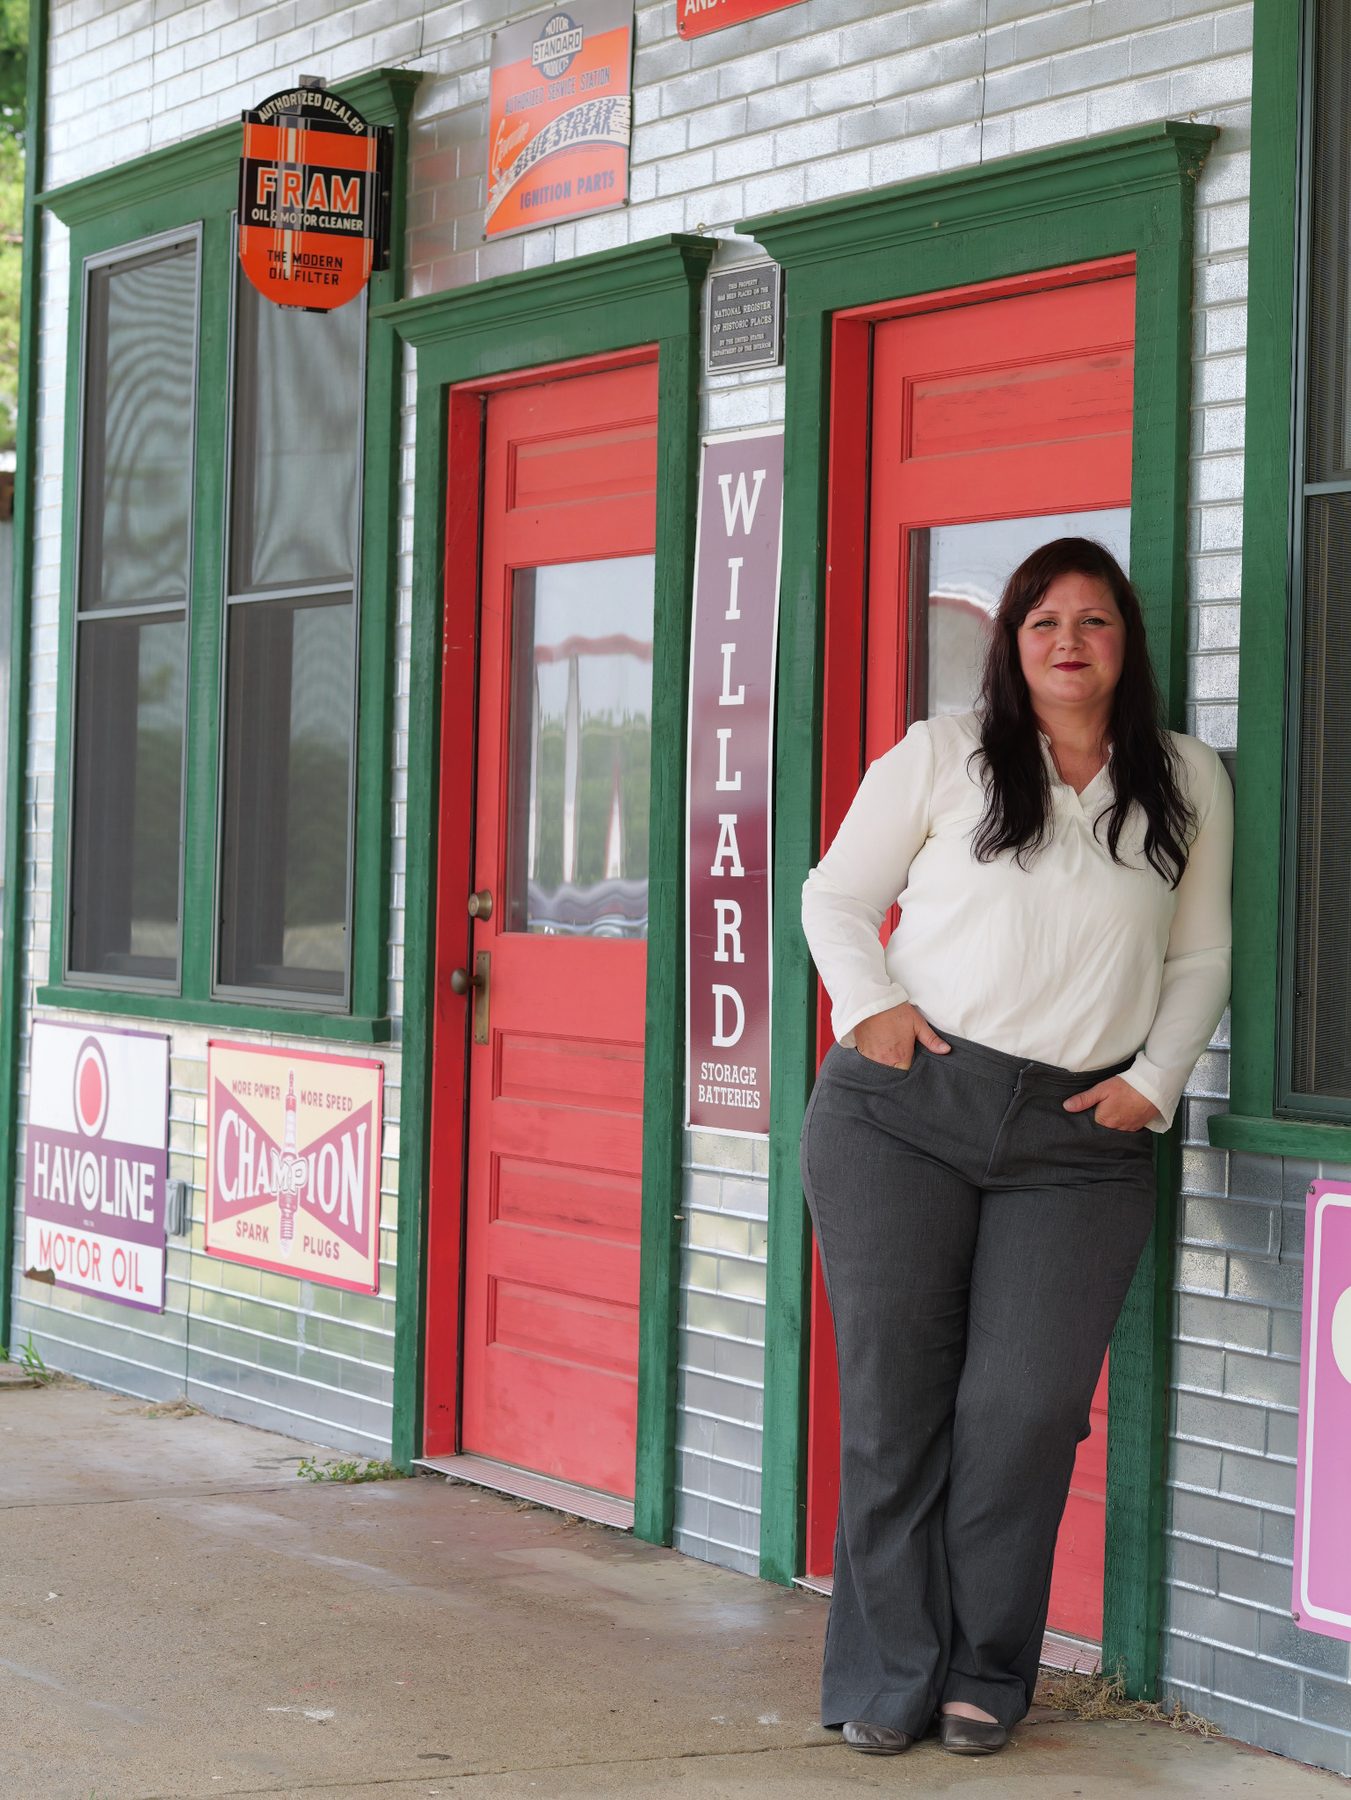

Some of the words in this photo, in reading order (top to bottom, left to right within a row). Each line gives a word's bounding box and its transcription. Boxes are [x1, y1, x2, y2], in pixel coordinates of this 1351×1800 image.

[545, 16, 569, 36] MOTOR
[534, 32, 580, 61] STANDARD
[548, 77, 576, 100] SERVICE
[580, 67, 611, 92] STATION
[258, 90, 322, 123] AUTHORIZED
[323, 97, 364, 135] DEALER
[513, 126, 551, 177] BLUE
[257, 167, 360, 215] FRAM
[520, 182, 571, 209] IGNITION
[578, 170, 615, 195] PARTS
[251, 209, 269, 221] OIL
[280, 212, 317, 226] MOTOR
[319, 215, 363, 231] CLEANER
[267, 250, 287, 262] THE
[293, 253, 343, 268] MODERN
[269, 267, 289, 280] OIL
[295, 270, 339, 285] FILTER
[713, 324, 721, 333] OF
[723, 319, 749, 331] HISTORIC
[751, 316, 772, 327] PLACES
[714, 306, 741, 318] NATIONAL
[743, 301, 771, 314] REGISTER
[711, 469, 767, 1047] WILLARD
[701, 1062, 756, 1085] STORAGE
[232, 1080, 252, 1096] MORE
[255, 1083, 280, 1101] POWER
[301, 1090, 323, 1107] MORE
[327, 1093, 353, 1112] SPEED
[698, 1085, 760, 1109] BATTERIES
[33, 1141, 155, 1223] HAVOLINE
[217, 1109, 367, 1234] CHAMPION
[236, 1220, 269, 1243] SPARK
[304, 1236, 340, 1260] PLUGS
[39, 1228, 101, 1282] MOTOR
[112, 1248, 143, 1293] OIL
